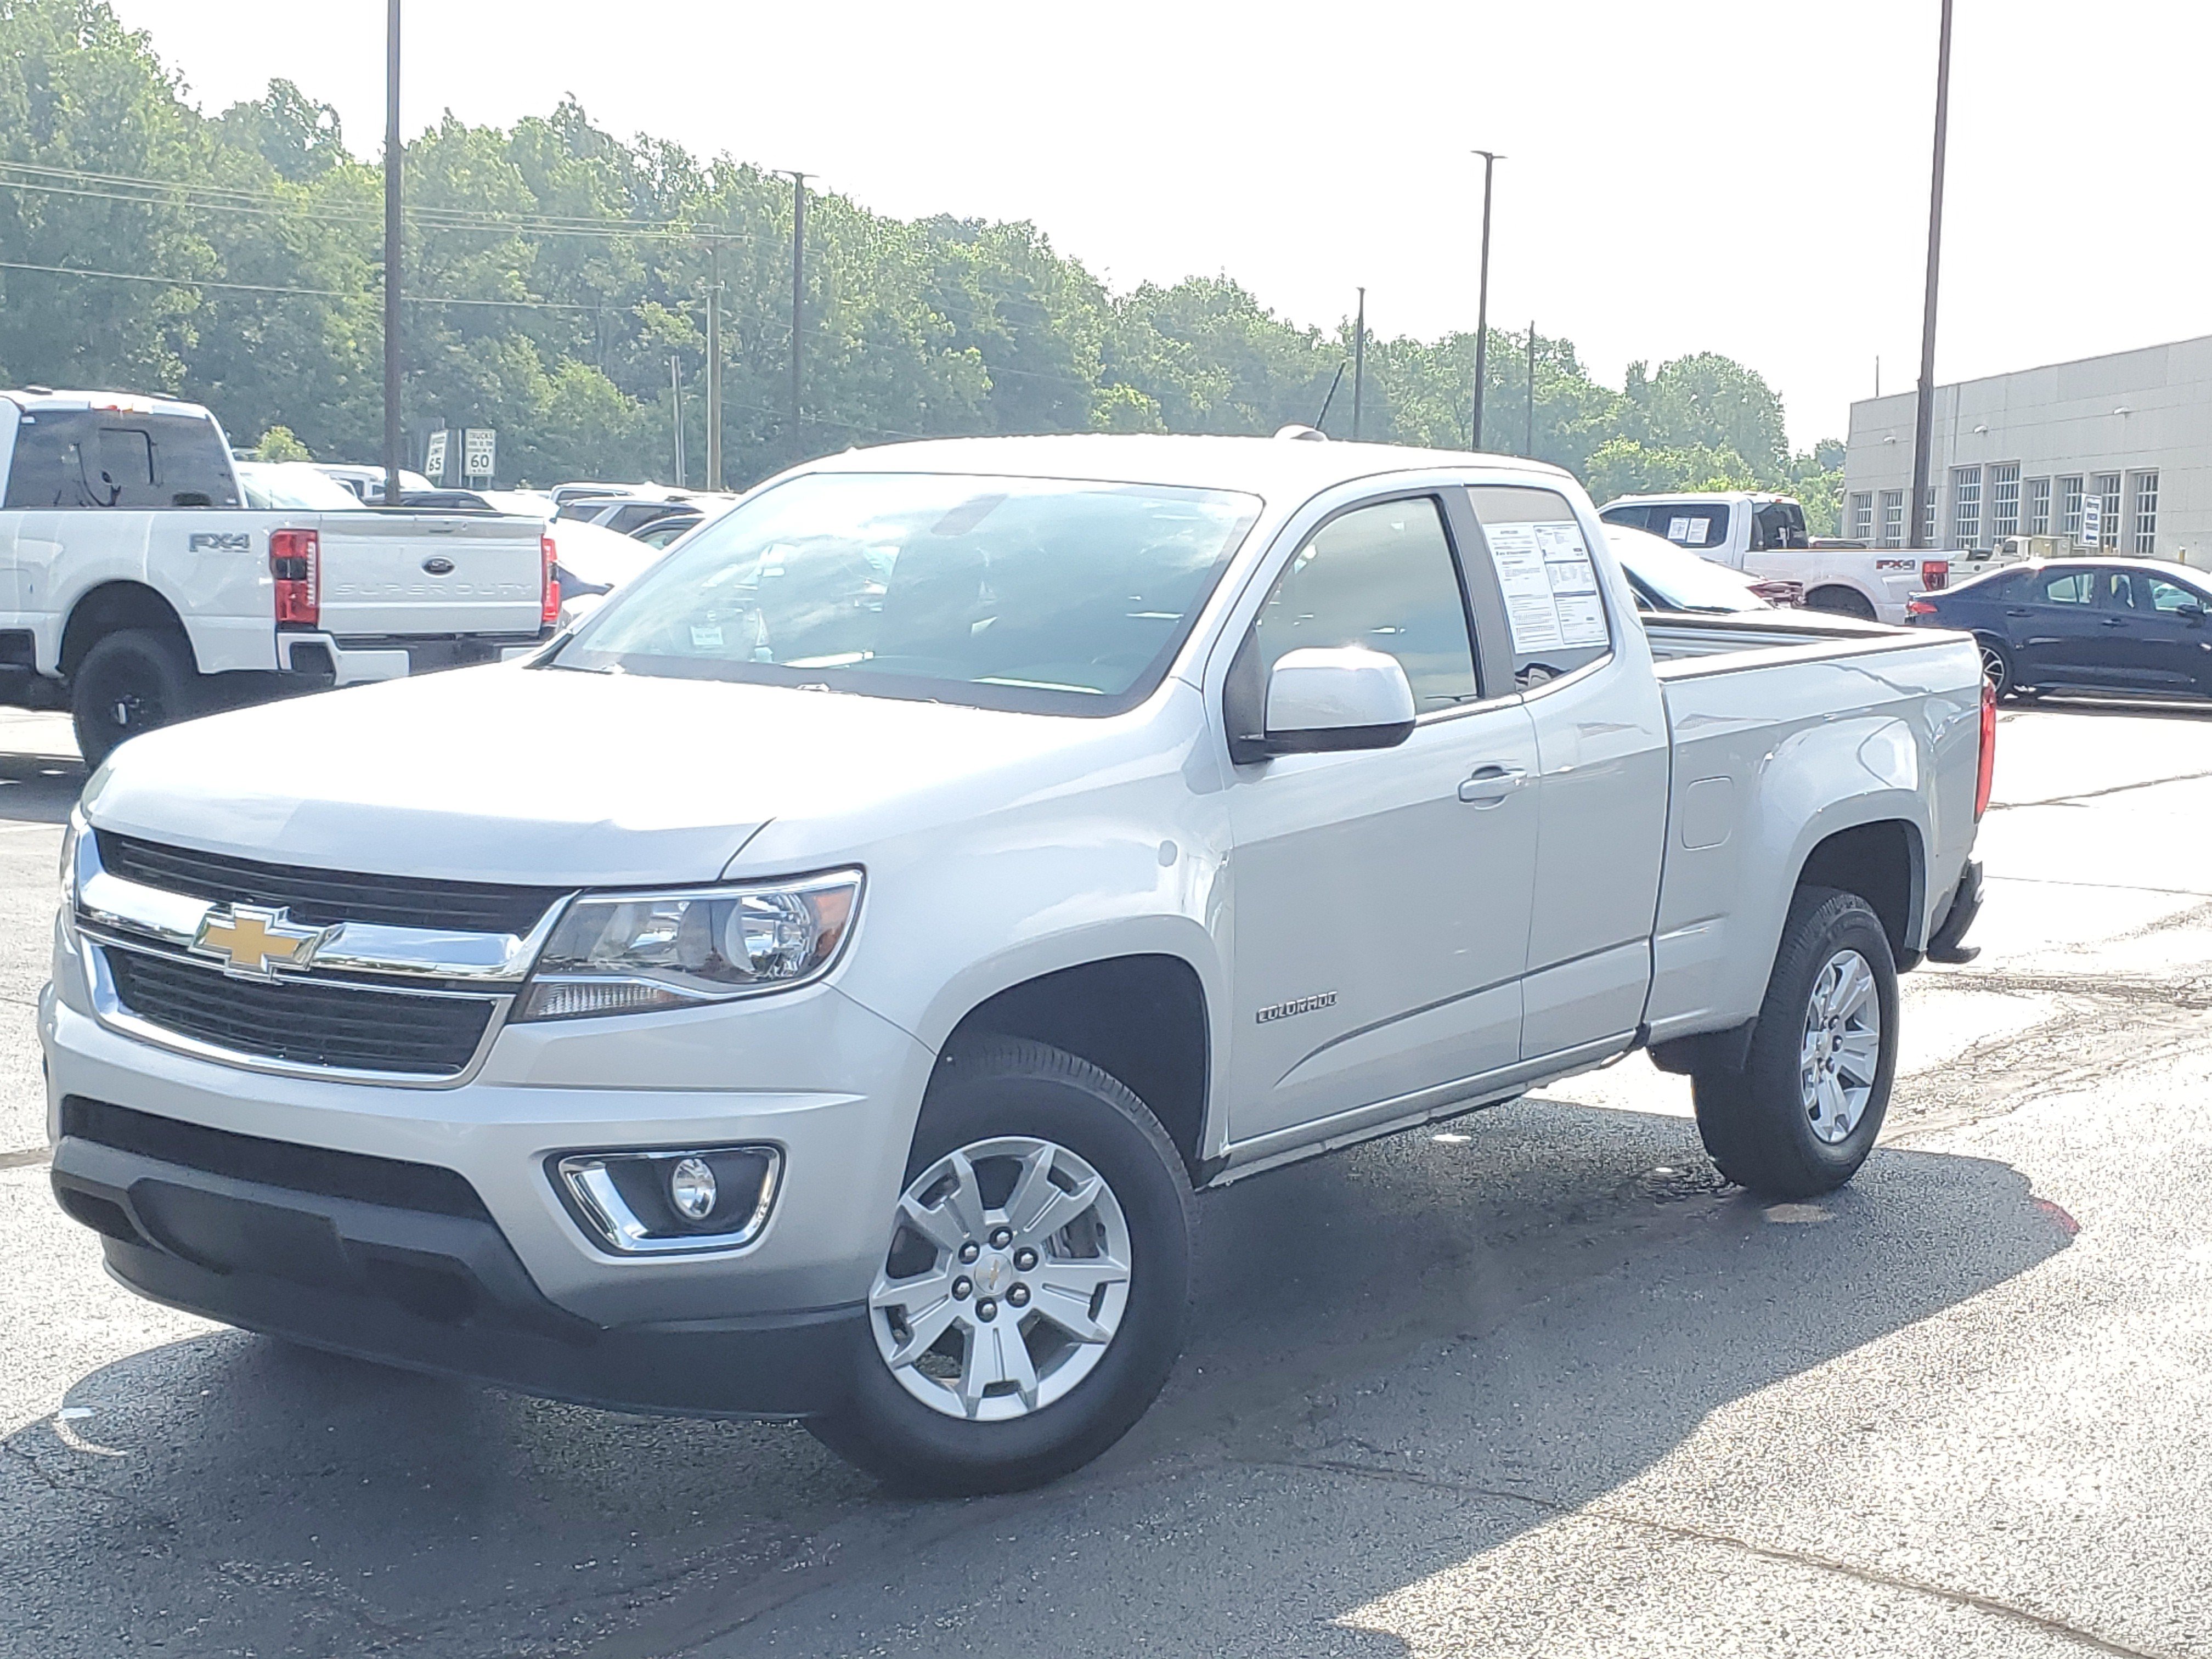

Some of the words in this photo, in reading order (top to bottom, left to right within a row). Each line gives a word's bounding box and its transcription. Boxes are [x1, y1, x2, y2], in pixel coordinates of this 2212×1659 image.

[429, 458, 441, 471] 65
[471, 454, 489, 468] 60
[189, 533, 251, 553] FX4
[1876, 560, 1916, 571] FX4
[334, 582, 448, 596] SUPER
[1256, 991, 1338, 1024] COLORADO
